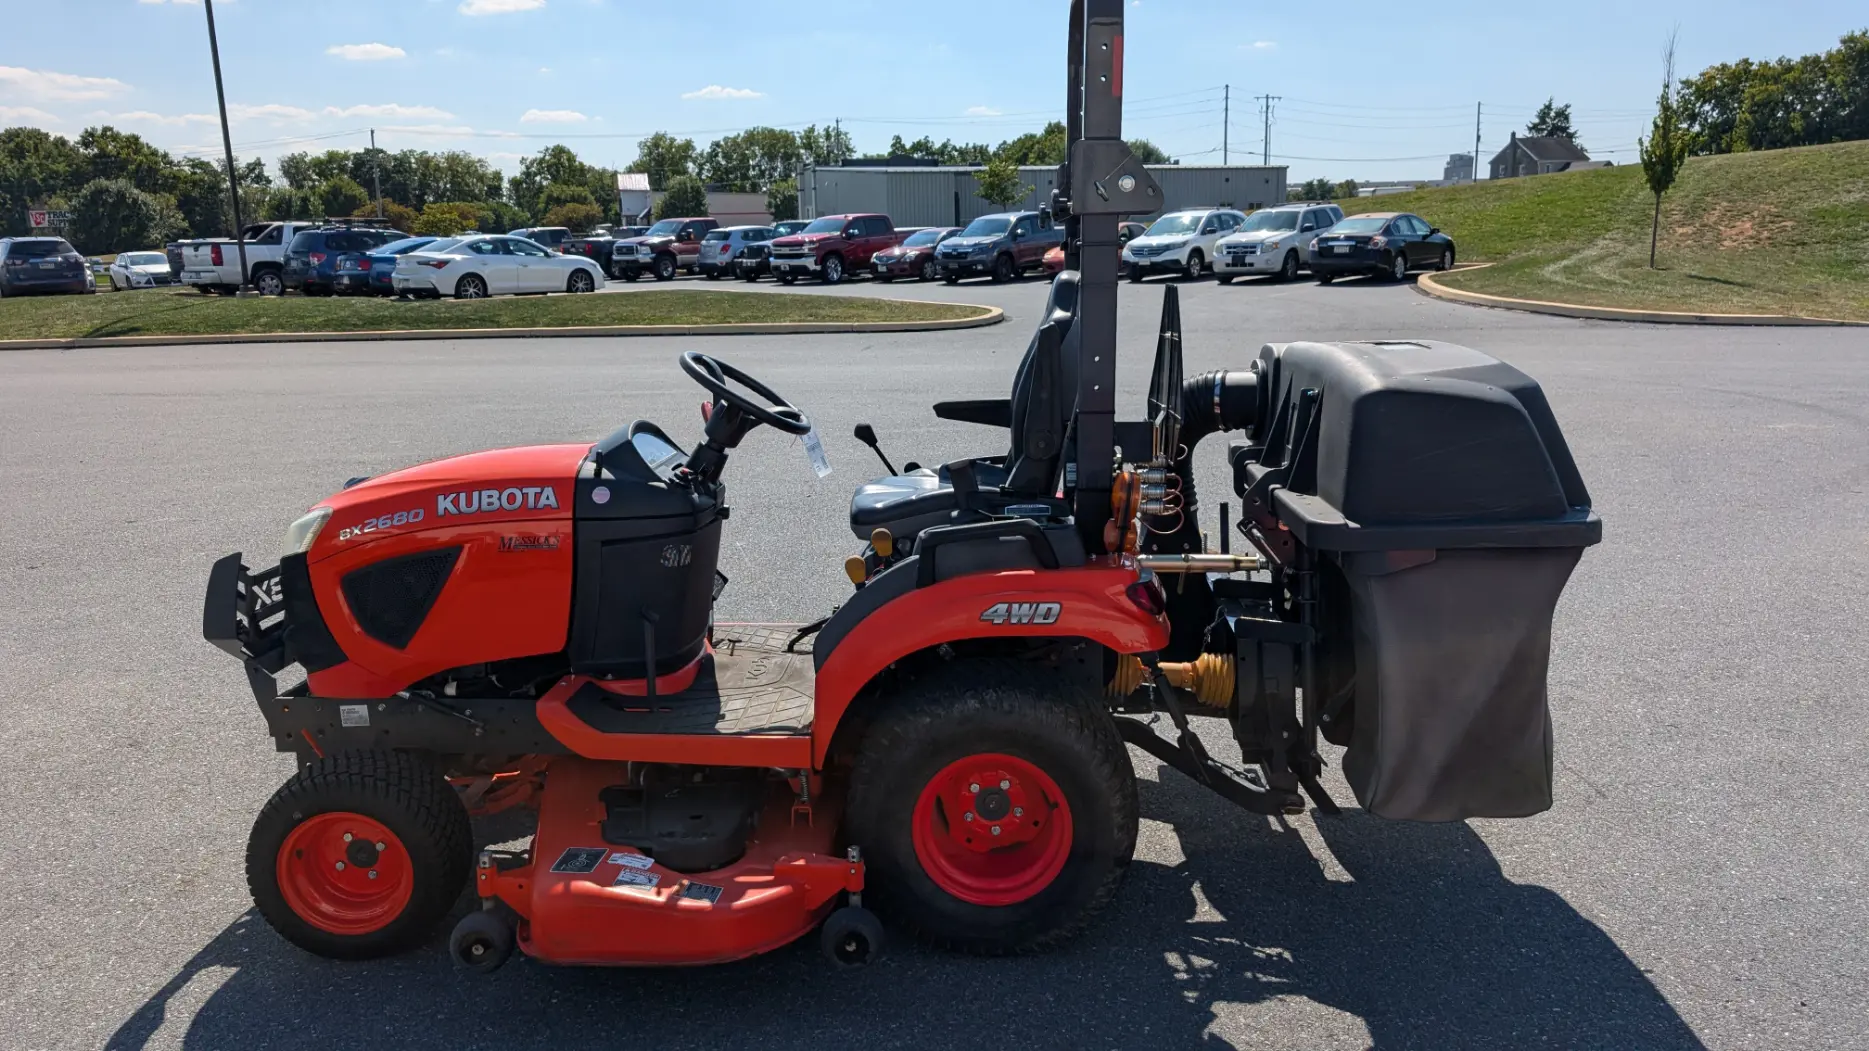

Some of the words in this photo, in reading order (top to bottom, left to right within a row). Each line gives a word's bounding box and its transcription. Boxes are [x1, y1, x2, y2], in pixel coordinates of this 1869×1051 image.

[47, 210, 72, 219] TRAC
[436, 486, 560, 517] KUBOTA
[338, 508, 425, 541] BX2680
[979, 601, 1062, 625] 4WD
